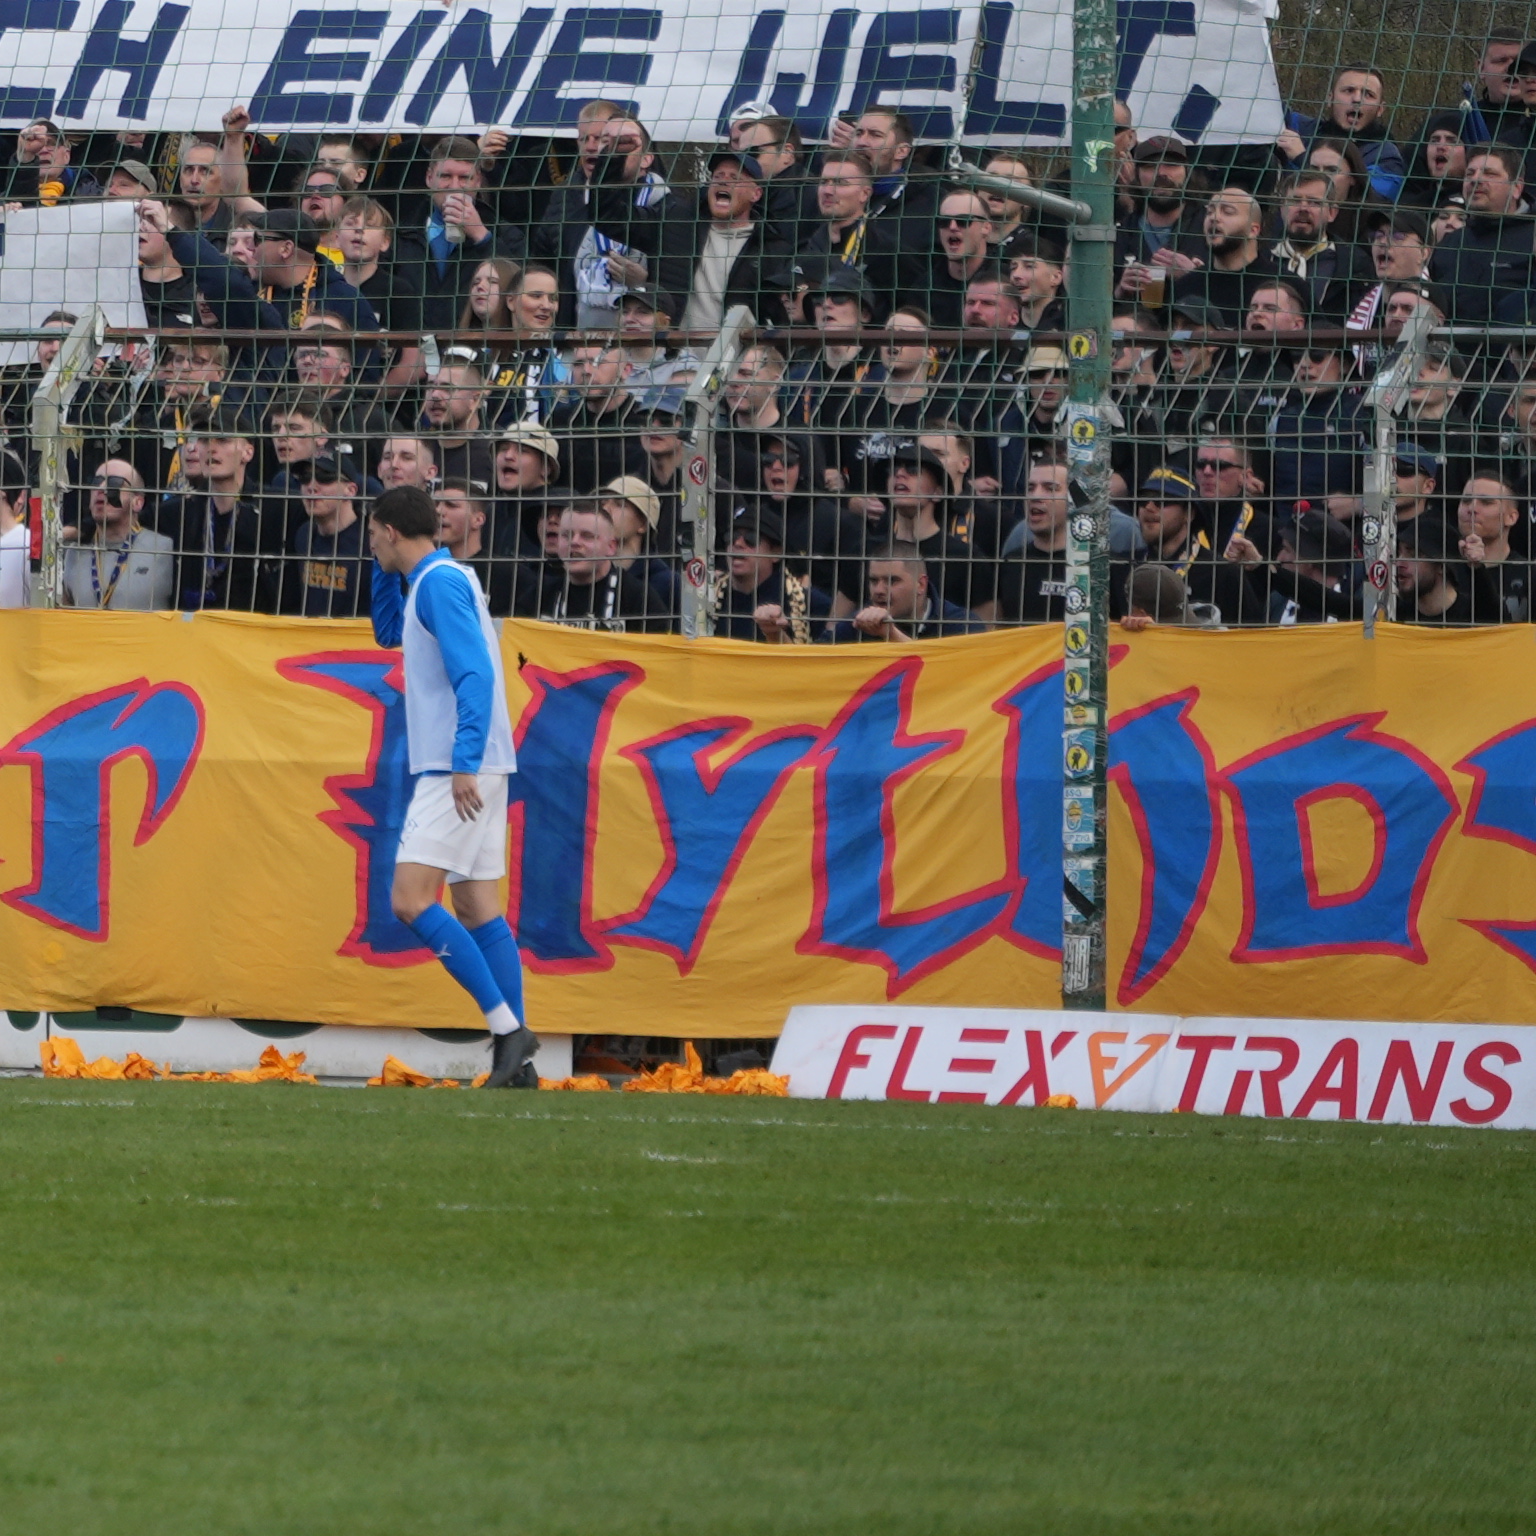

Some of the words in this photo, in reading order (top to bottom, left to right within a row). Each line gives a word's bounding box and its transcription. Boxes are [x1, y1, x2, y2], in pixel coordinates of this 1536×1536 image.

[249, 6, 662, 129] EINE
[824, 1023, 1078, 1107] FLEX
[1170, 1034, 1522, 1125] TRANS
